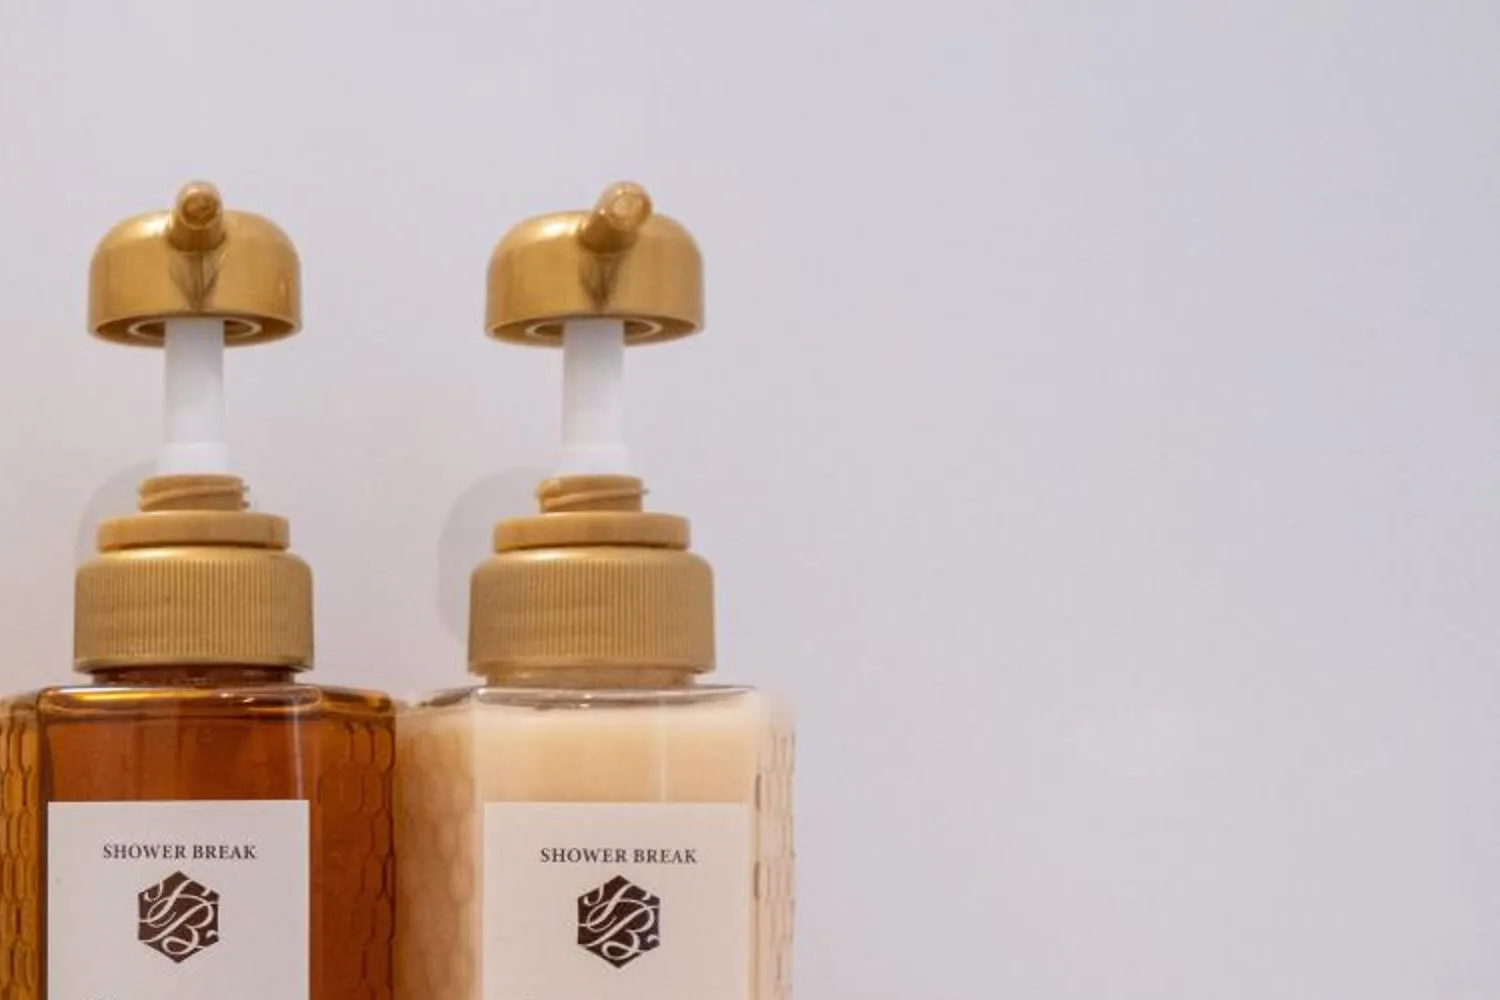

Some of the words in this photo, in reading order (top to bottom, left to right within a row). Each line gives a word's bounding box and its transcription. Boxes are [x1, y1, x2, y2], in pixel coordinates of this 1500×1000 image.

[102, 844, 187, 860] SHOWER
[192, 844, 257, 860] BREAK
[540, 848, 627, 863] SHOWER
[633, 848, 698, 864] BREAK
